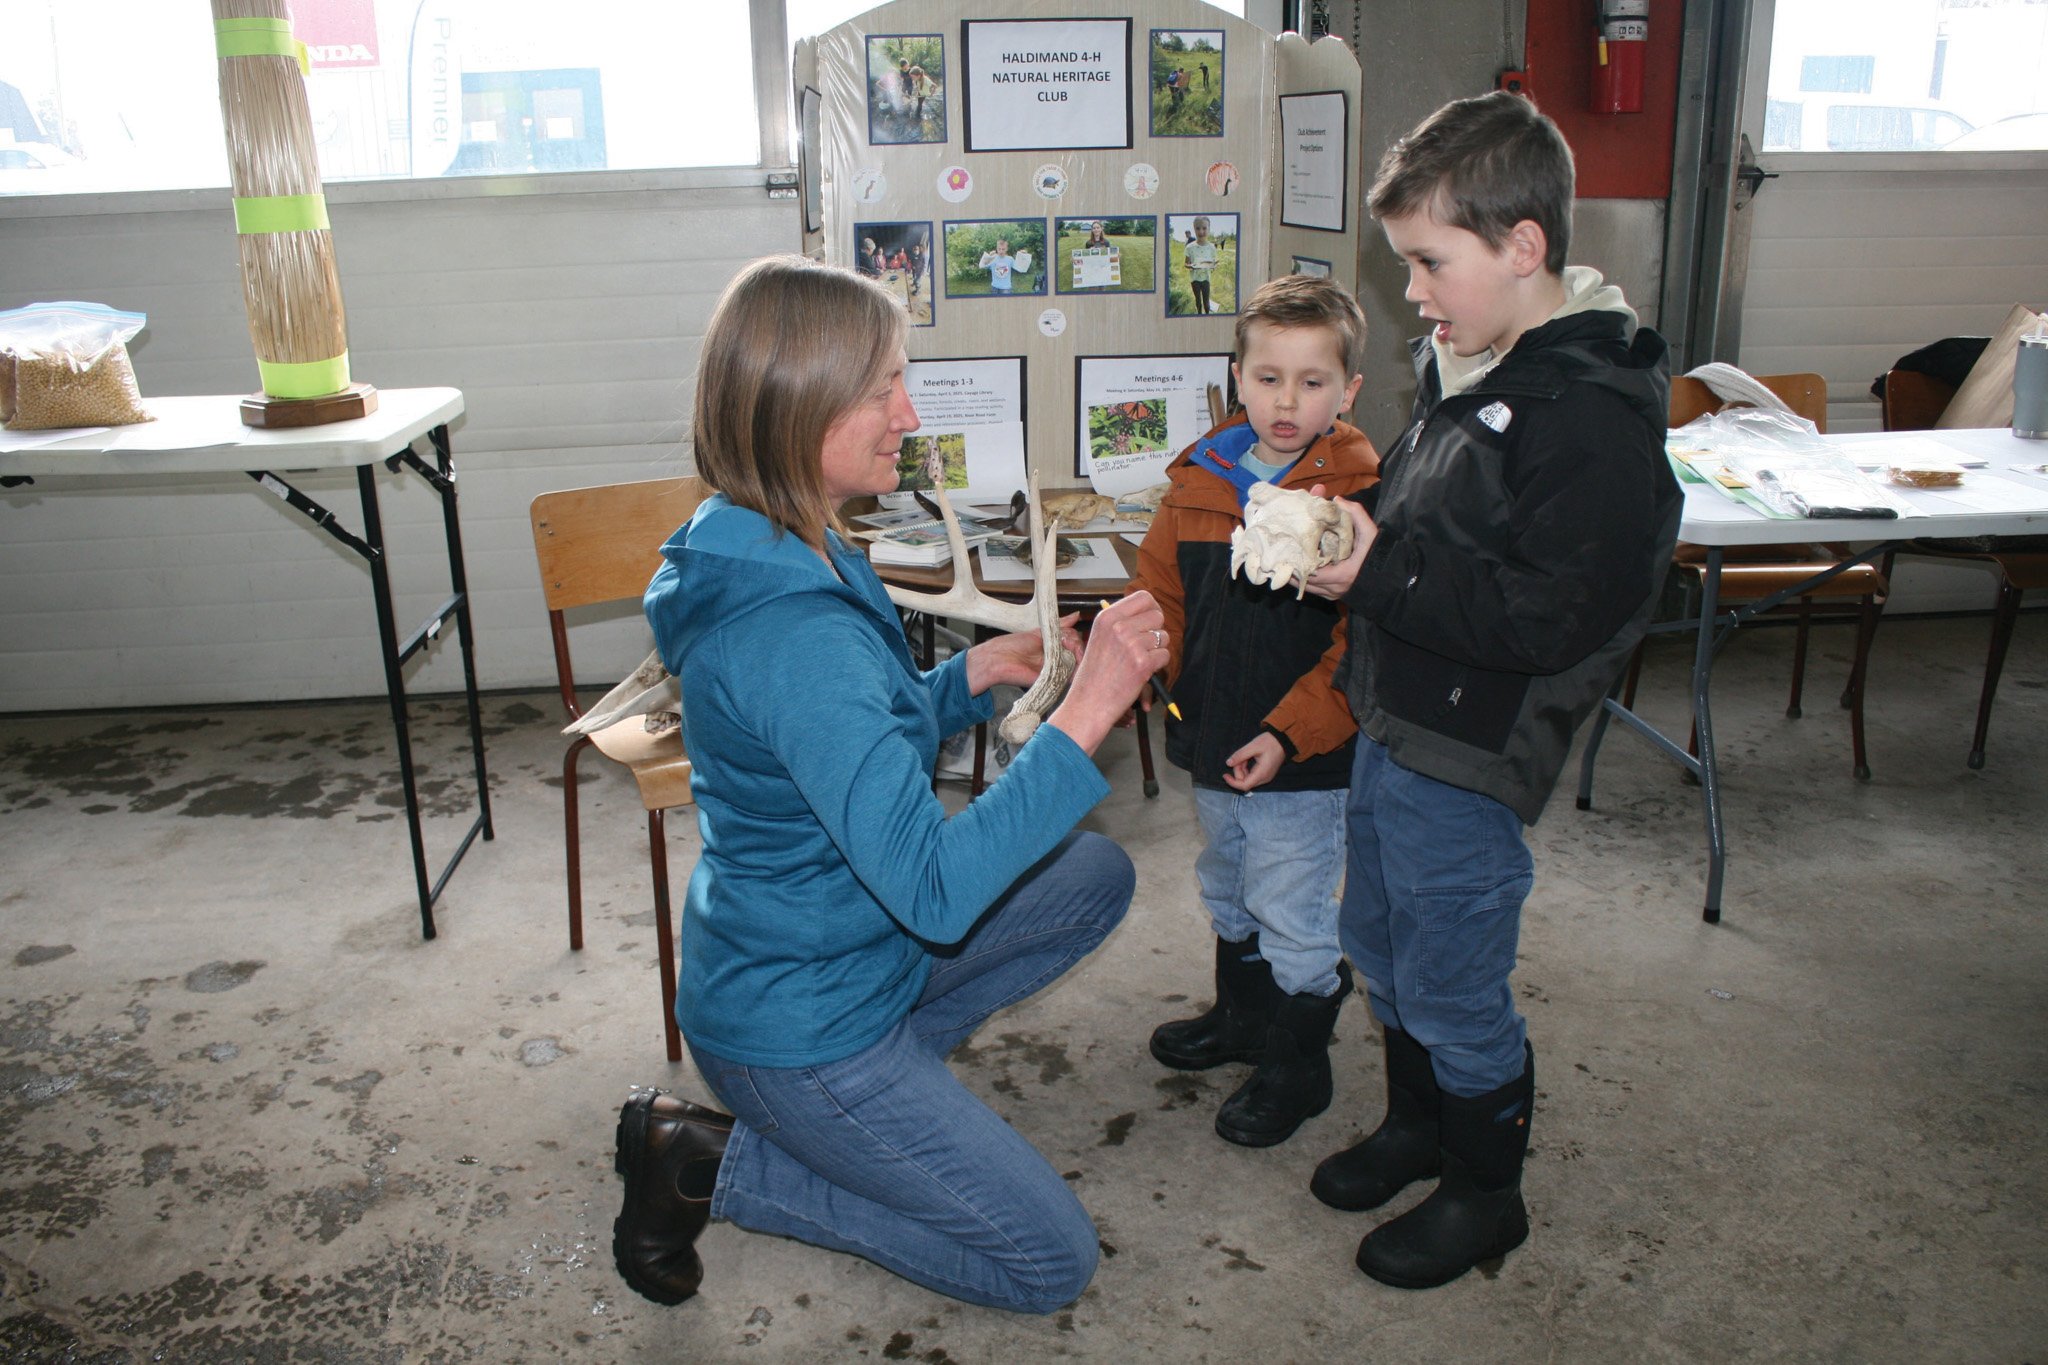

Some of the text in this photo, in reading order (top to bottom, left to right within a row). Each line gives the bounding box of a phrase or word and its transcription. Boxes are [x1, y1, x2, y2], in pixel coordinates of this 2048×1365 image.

[306, 44, 374, 62] NDA
[1002, 51, 1101, 64] HALDIMAND 4-H
[432, 17, 451, 147] Premier
[992, 71, 1111, 84] NATURAL HERITAGE
[1037, 91, 1068, 102] CLUB
[923, 378, 959, 387] Meetings
[1134, 375, 1170, 384] Meetings
[1095, 460, 1109, 468] Can
[1112, 458, 1124, 466] you
[1149, 452, 1162, 460] this
[1165, 447, 1181, 458] nati
